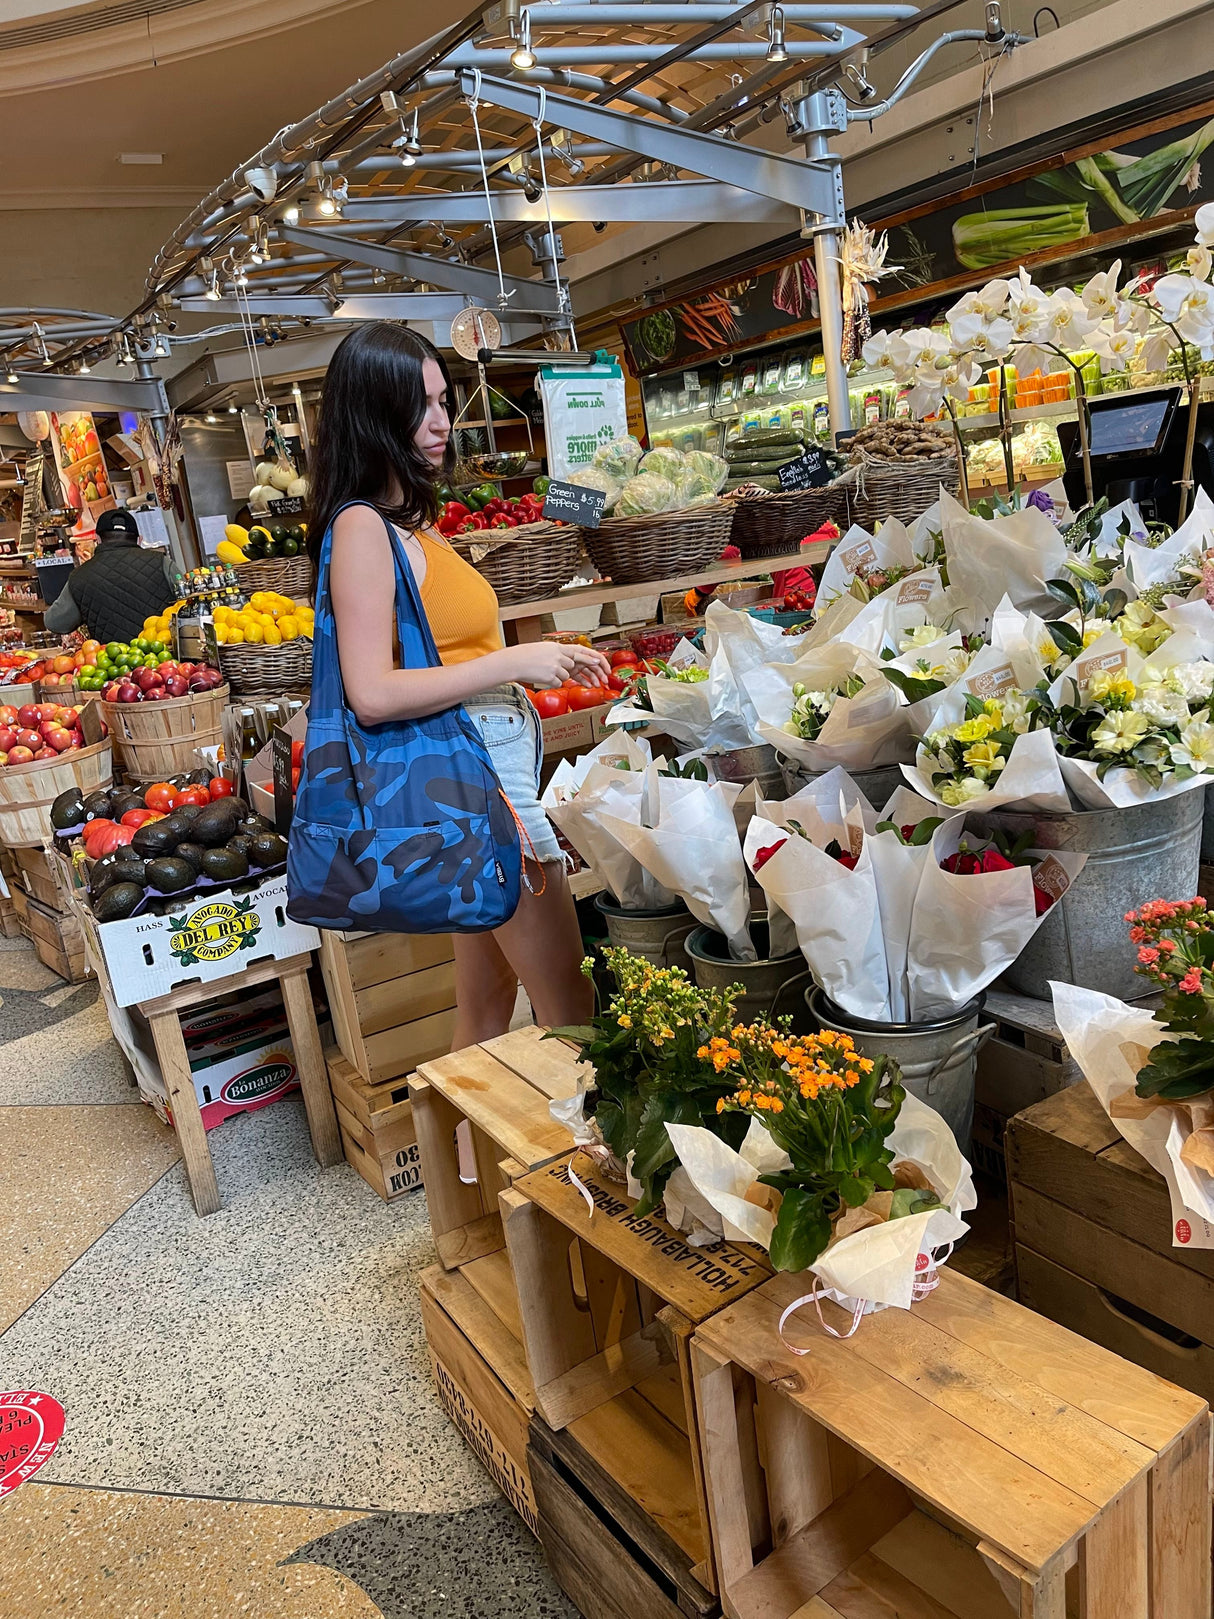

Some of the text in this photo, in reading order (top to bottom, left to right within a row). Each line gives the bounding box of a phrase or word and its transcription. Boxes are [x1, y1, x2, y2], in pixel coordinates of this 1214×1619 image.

[548, 483, 575, 498] Green
[545, 495, 580, 511] Peppers
[43, 558, 68, 566] LOCAL
[252, 885, 288, 902] AVOCA
[135, 920, 164, 933] HASS
[193, 905, 234, 928] AVOCADO
[183, 916, 248, 948] DEL REY
[196, 936, 240, 958] COMPANY
[231, 1068, 287, 1098] Bonanza
[618, 1212, 740, 1294] HOLLABAUGH
[18, 1440, 56, 1479] NEW
